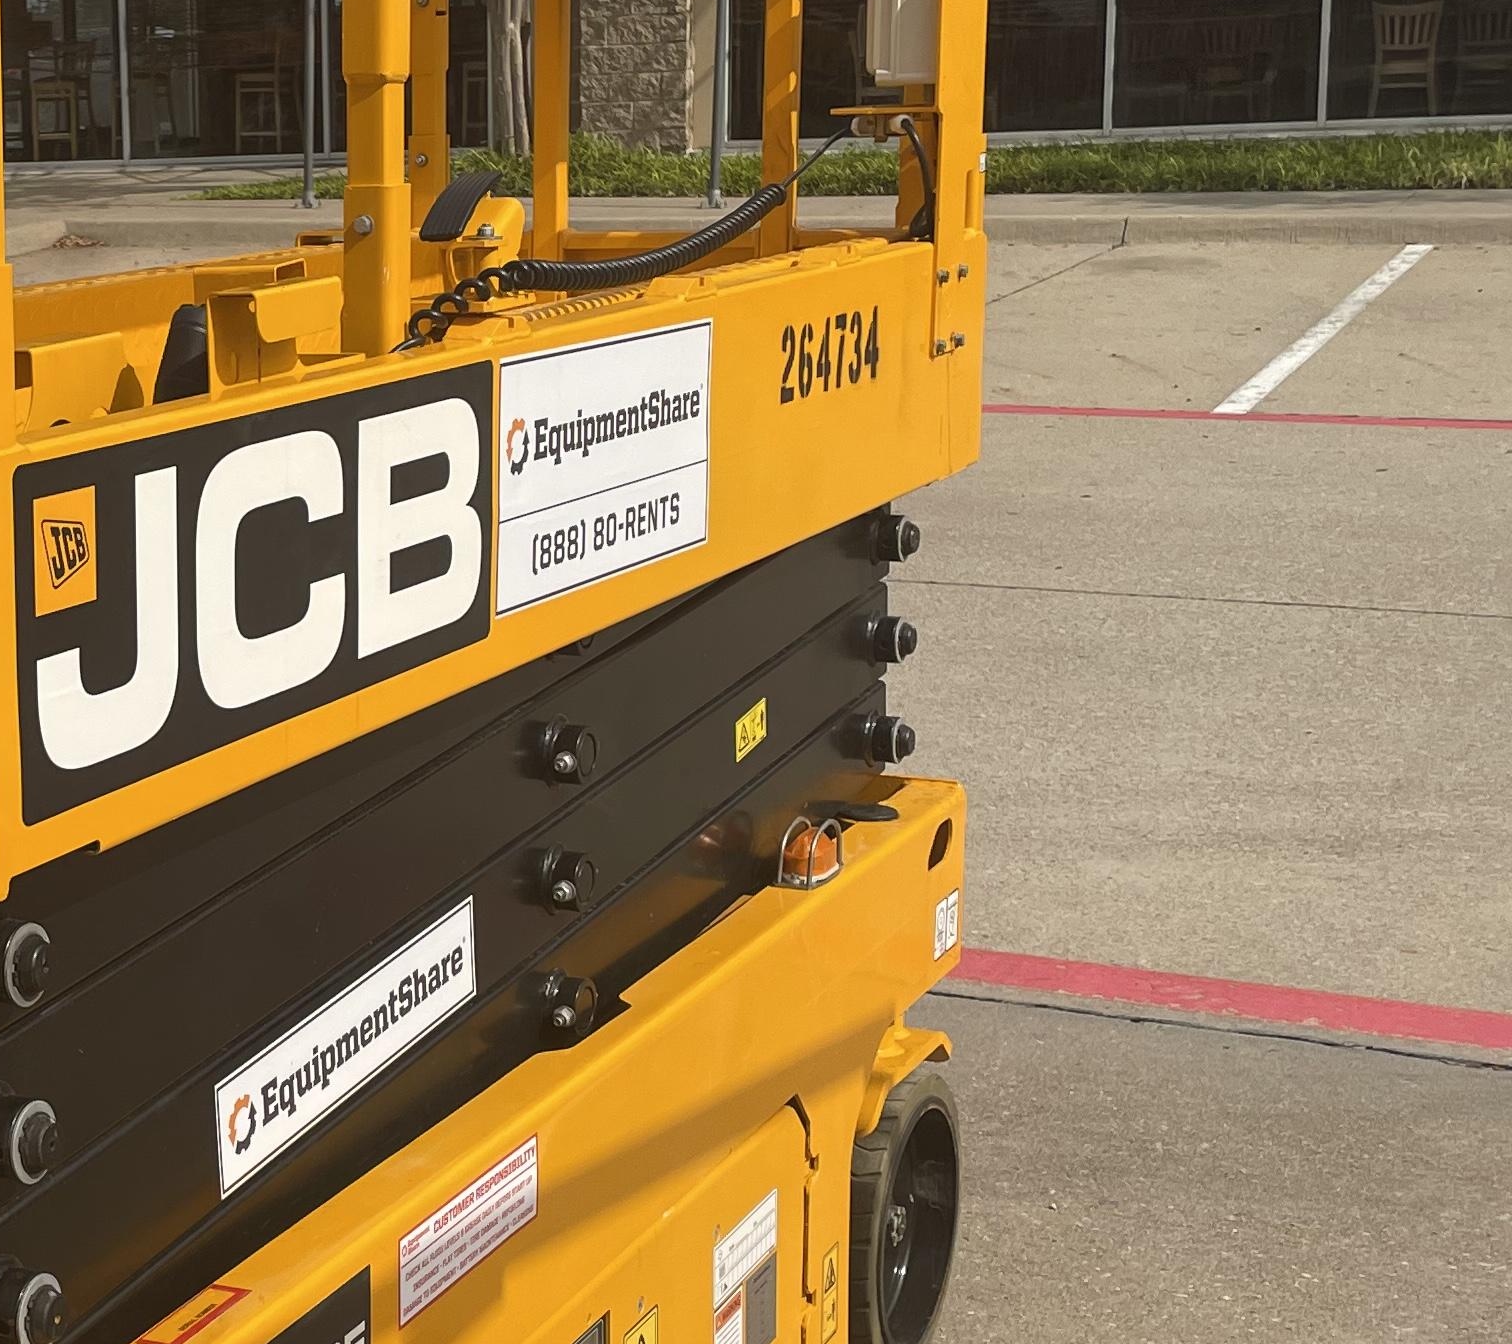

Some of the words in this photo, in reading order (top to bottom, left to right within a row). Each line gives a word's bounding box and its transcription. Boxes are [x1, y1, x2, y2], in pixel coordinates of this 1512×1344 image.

[778, 305, 880, 404] 264734
[533, 387, 702, 466] EquipmentShare
[41, 520, 90, 589] JCB
[530, 517, 587, 575] (888)
[593, 492, 682, 552] 80-RENTS
[36, 397, 482, 771] JCB
[260, 946, 463, 1126] EquipmentShare
[433, 1193, 474, 1234] CUSTOMER
[476, 1144, 535, 1200] RESPONSIBILITY
[405, 1262, 420, 1281] CHECK
[421, 1255, 429, 1268] ALL
[445, 1231, 459, 1250] LEVELS
[430, 1265, 456, 1294] EQUIPMENT
